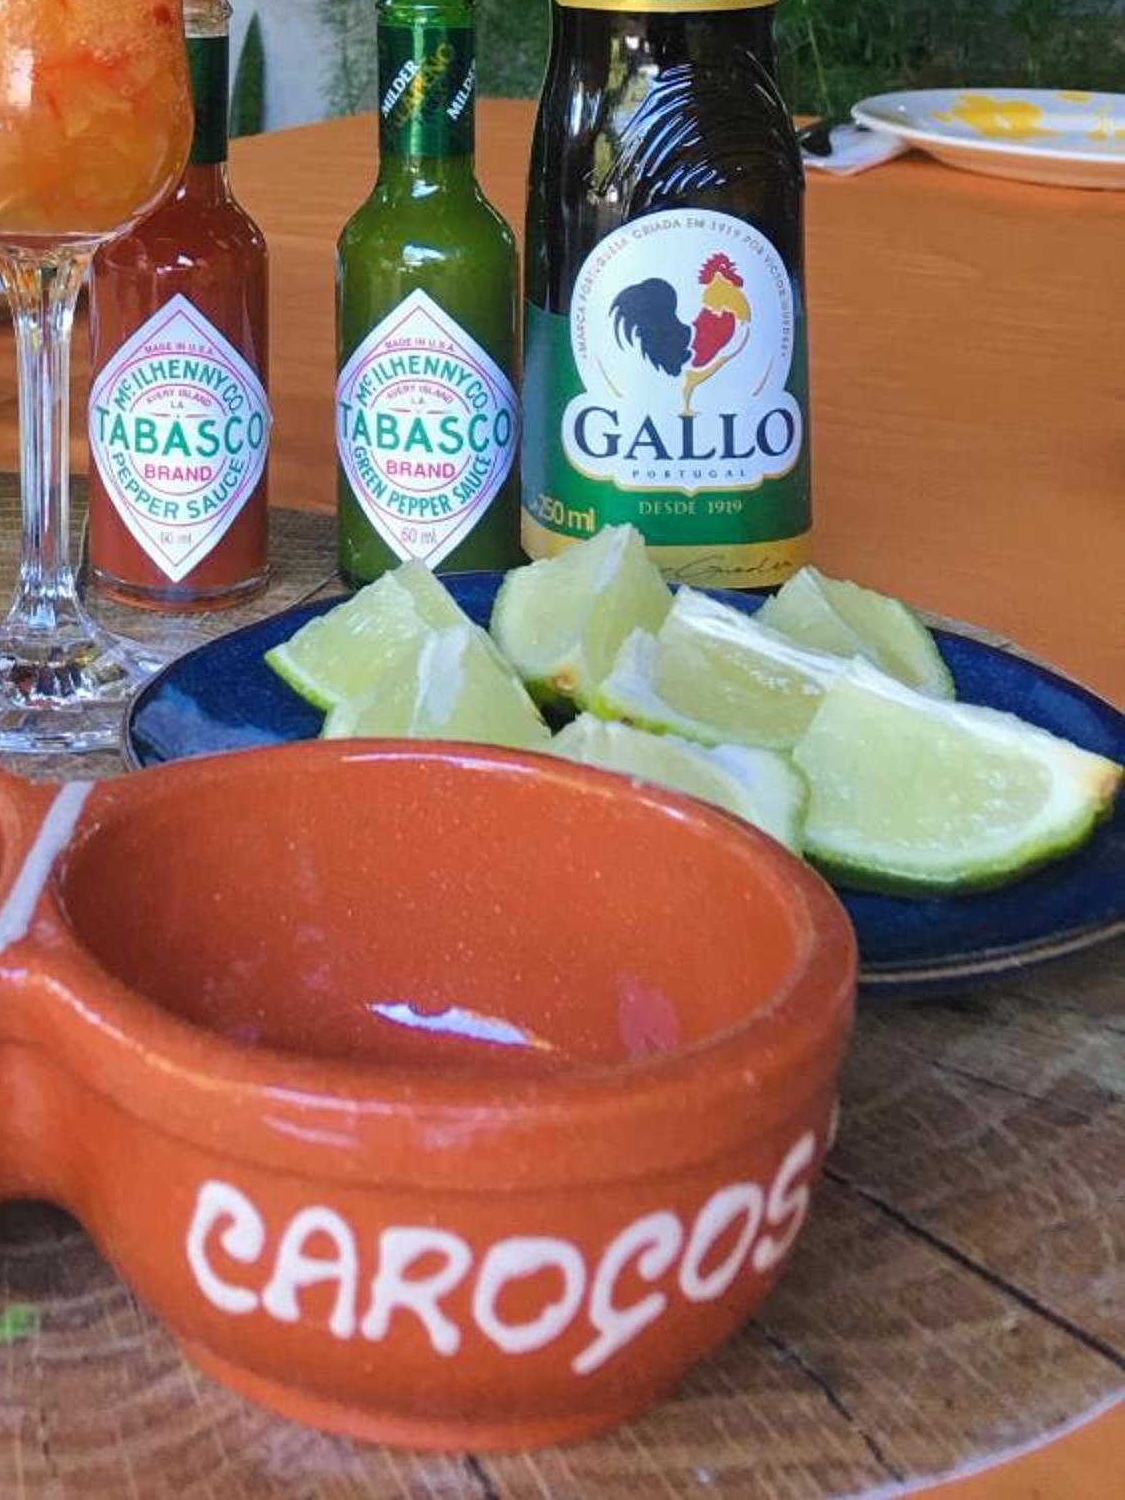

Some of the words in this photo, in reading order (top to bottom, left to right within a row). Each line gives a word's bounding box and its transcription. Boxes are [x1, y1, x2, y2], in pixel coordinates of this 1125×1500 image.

[96, 405, 264, 458] TABASCO
[339, 401, 511, 455] TABASCO
[573, 405, 796, 461] GALLO
[112, 451, 180, 519] PEPPER
[186, 455, 245, 519] SAUCE
[144, 463, 213, 482] BRAND
[354, 445, 389, 500] GREEN
[387, 490, 452, 518] PEPPER
[452, 453, 492, 505] SAUCE
[385, 459, 456, 479] BRAND
[631, 468, 748, 479] PORTUGAL
[638, 500, 697, 516] DESDE
[707, 500, 744, 516] 1919
[186, 1130, 816, 1376] CAROÇOS
